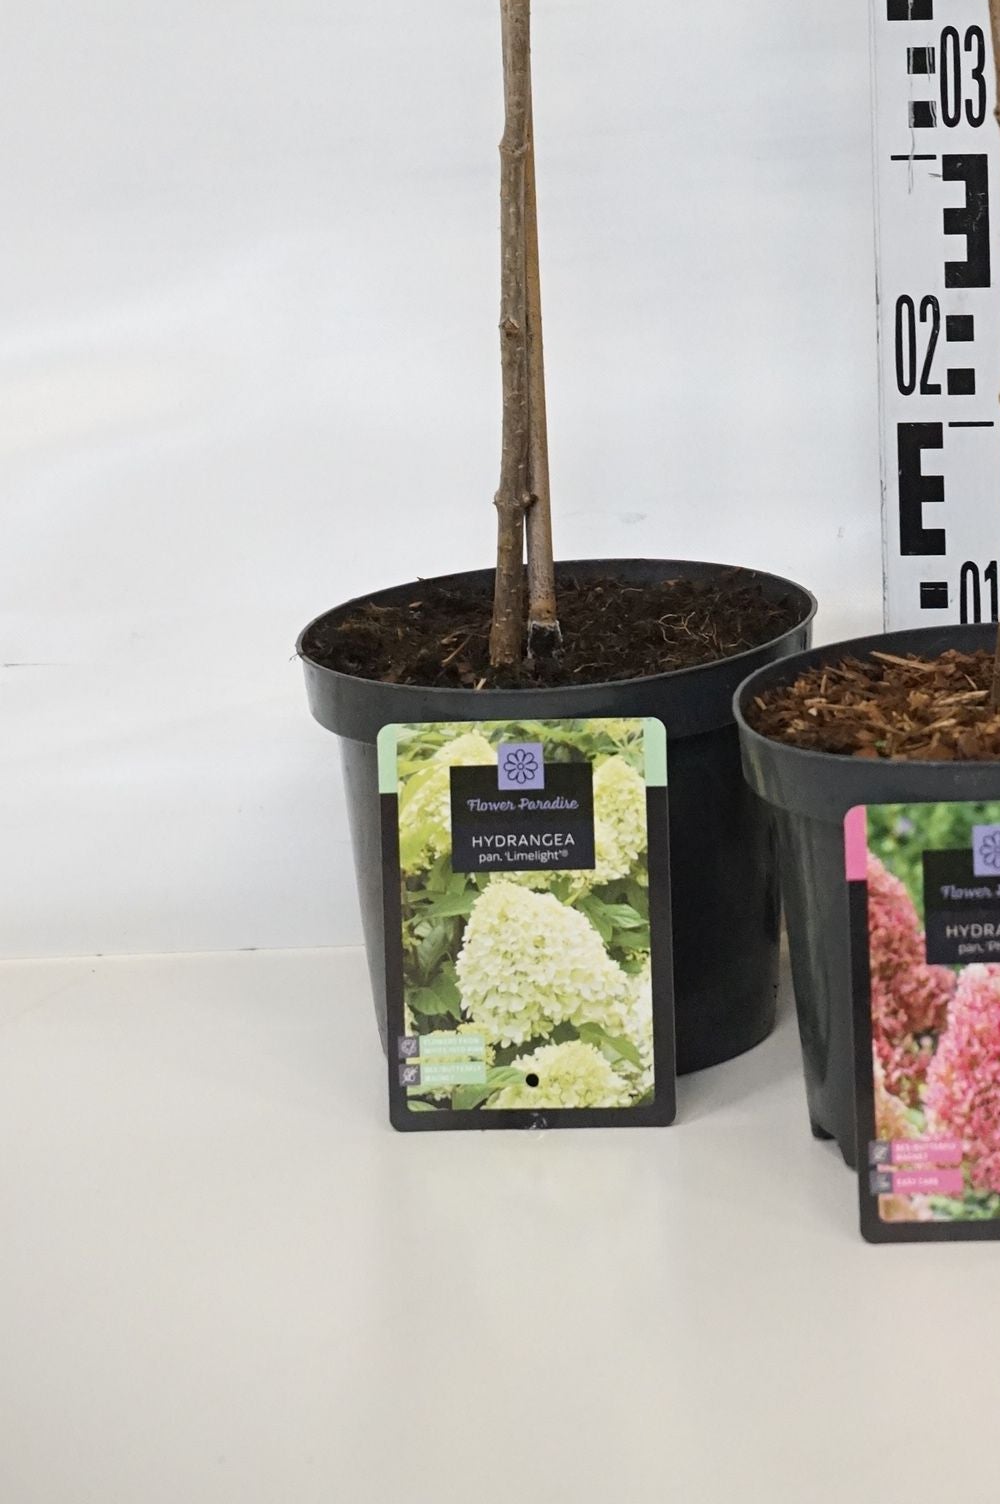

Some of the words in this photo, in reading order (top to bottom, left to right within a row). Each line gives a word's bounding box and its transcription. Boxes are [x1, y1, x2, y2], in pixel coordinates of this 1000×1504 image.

[939, 24, 987, 128] 03
[895, 294, 942, 395] 02
[959, 560, 999, 625] 01
[466, 798, 516, 812] Flower
[517, 796, 579, 811] Paradise
[472, 833, 576, 848] HYDRANGEA
[478, 852, 503, 864] pan.
[940, 884, 993, 900] Flower
